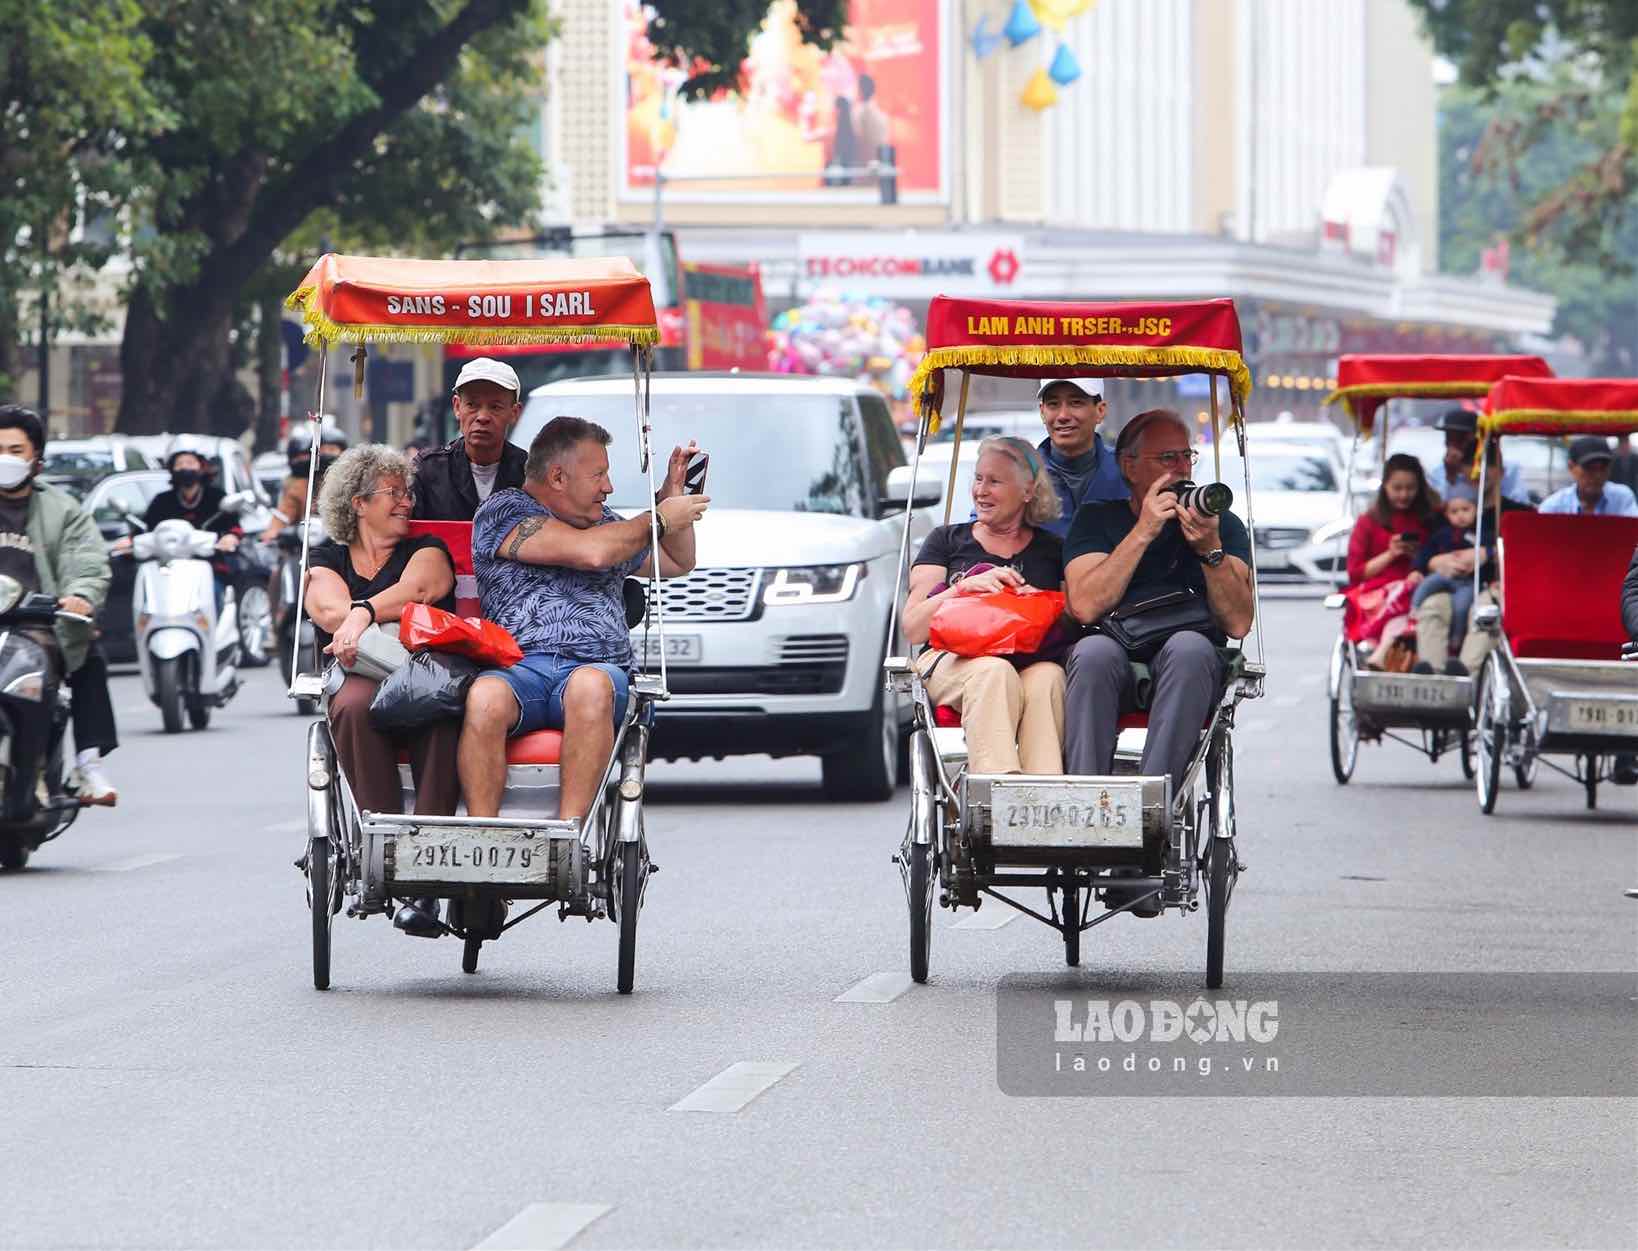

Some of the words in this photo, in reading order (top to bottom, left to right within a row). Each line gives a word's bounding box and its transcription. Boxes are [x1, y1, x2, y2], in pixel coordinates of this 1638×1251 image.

[387, 295, 446, 315] SANS
[468, 295, 511, 318] SOU
[540, 292, 595, 317] SARL
[967, 316, 1009, 336] LAM
[1014, 316, 1055, 336] ANH
[412, 844, 532, 868] 29XL-0079
